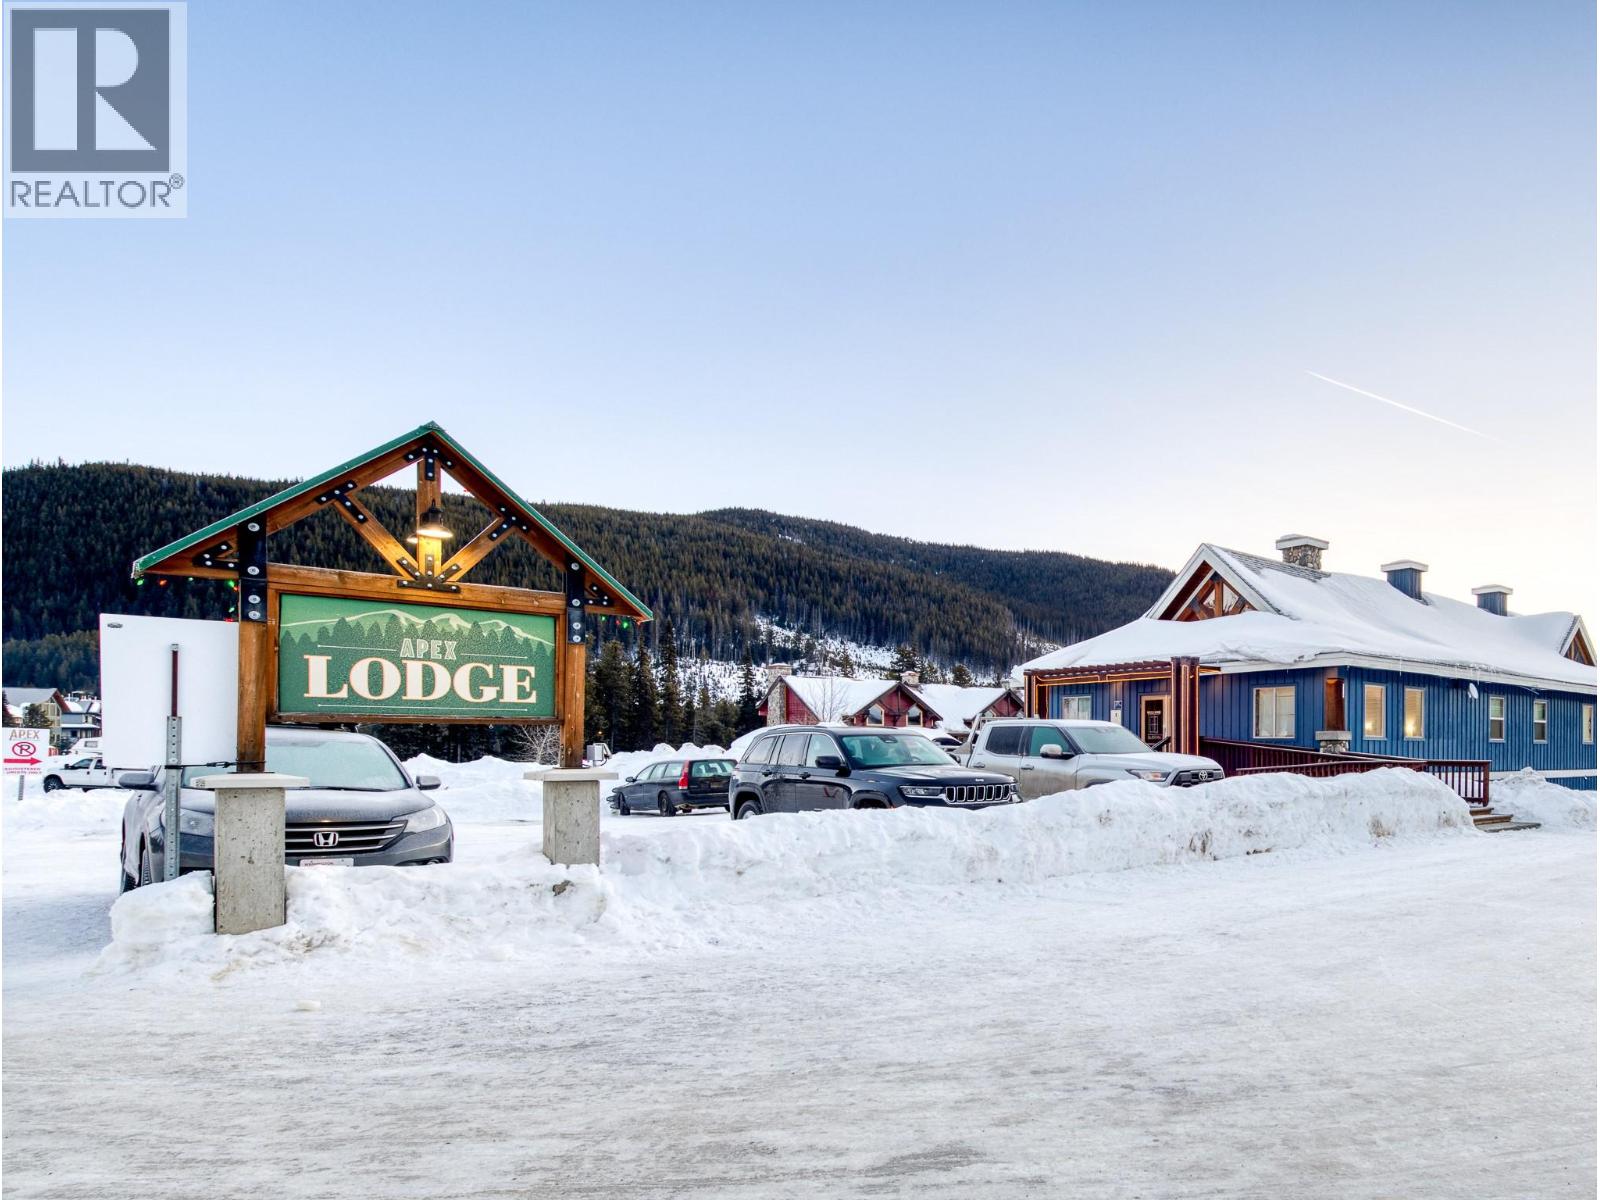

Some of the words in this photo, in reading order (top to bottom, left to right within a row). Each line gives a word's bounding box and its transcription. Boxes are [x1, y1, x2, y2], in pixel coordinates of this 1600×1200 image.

[400, 638, 457, 660] APEX
[304, 655, 537, 704] LODGE
[10, 729, 40, 740] APEX
